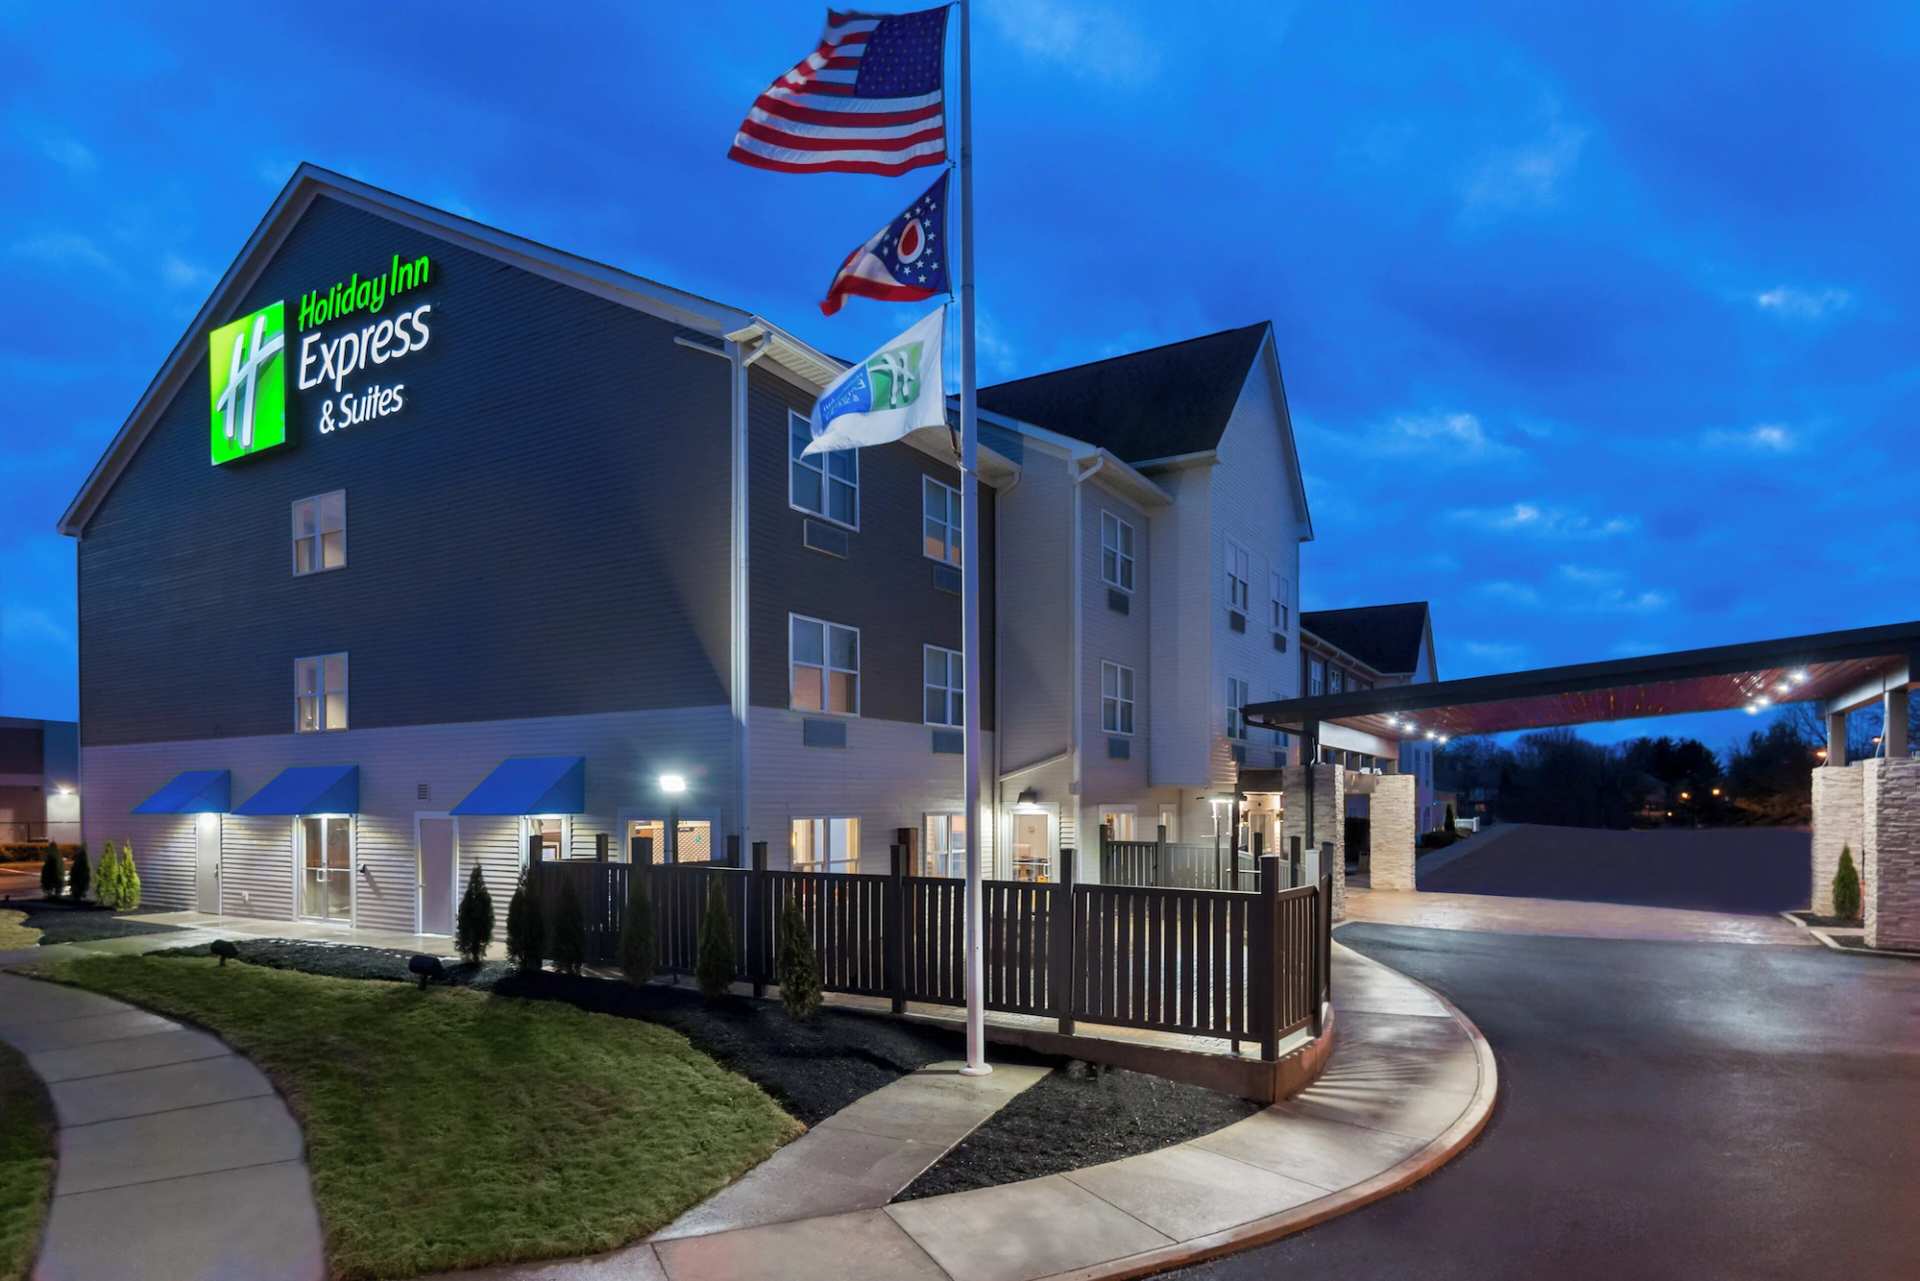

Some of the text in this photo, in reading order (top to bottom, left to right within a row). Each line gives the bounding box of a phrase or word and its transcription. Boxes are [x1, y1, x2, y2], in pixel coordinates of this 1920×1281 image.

[298, 254, 430, 332] Holiday Inn
[298, 304, 432, 393] Express
[319, 384, 405, 435] & Suites
